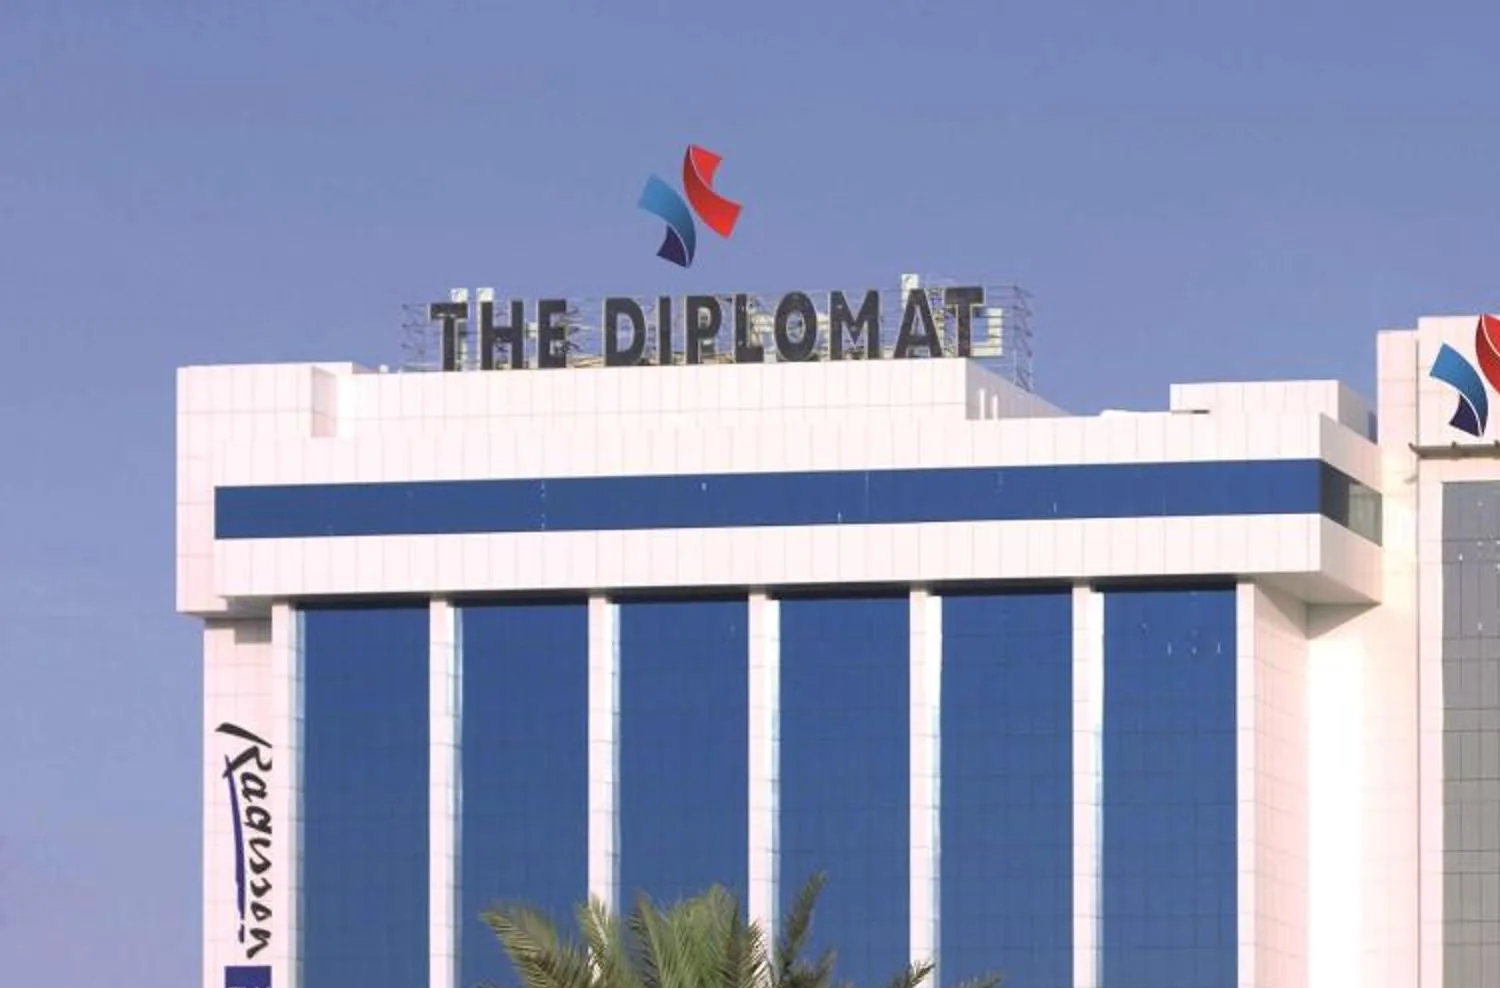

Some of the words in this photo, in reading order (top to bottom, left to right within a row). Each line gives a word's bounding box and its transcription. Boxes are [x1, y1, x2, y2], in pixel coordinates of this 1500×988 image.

[429, 298, 568, 372] THE
[603, 284, 986, 367] DIPLOMAT
[214, 722, 273, 960] Radisson
